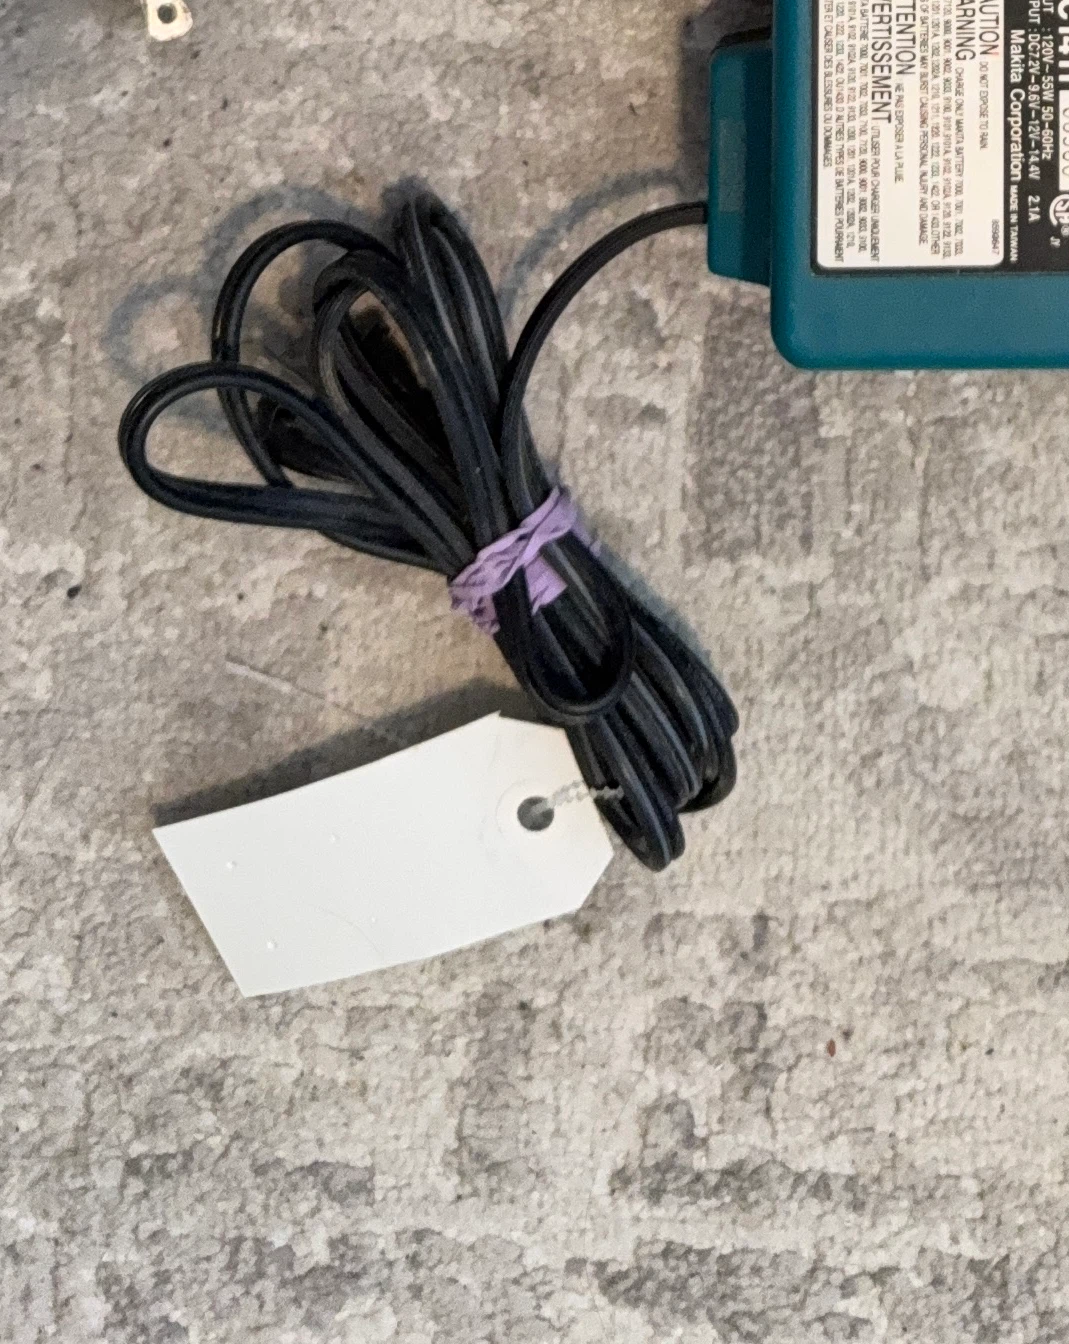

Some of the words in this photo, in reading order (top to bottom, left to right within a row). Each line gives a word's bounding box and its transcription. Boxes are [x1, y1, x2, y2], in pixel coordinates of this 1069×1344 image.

[920, 4, 930, 14] OF
[920, 16, 930, 52] BATTERIES
[979, 62, 988, 72] DO
[1010, 29, 1024, 84] Makita
[920, 72, 930, 95] BURST
[954, 67, 964, 96] CHARGE
[979, 74, 988, 88] NOT
[954, 99, 964, 116] ONLY
[979, 90, 988, 118] EXPOSE
[895, 110, 904, 143] EXPOSER
[979, 120, 988, 130] TO
[1007, 88, 1026, 181] Corporation
[1042, 106, 1053, 160] 50-60Hz
[920, 130, 930, 168] PERSONAL
[954, 146, 964, 177] BATTERY
[870, 180, 880, 214] CHARGER
[920, 197, 930, 212] AND
[1010, 185, 1018, 210] MADE
[1028, 195, 1040, 222] 2.1A
[1010, 213, 1018, 223] IN
[1010, 226, 1018, 262] TAIWAN
